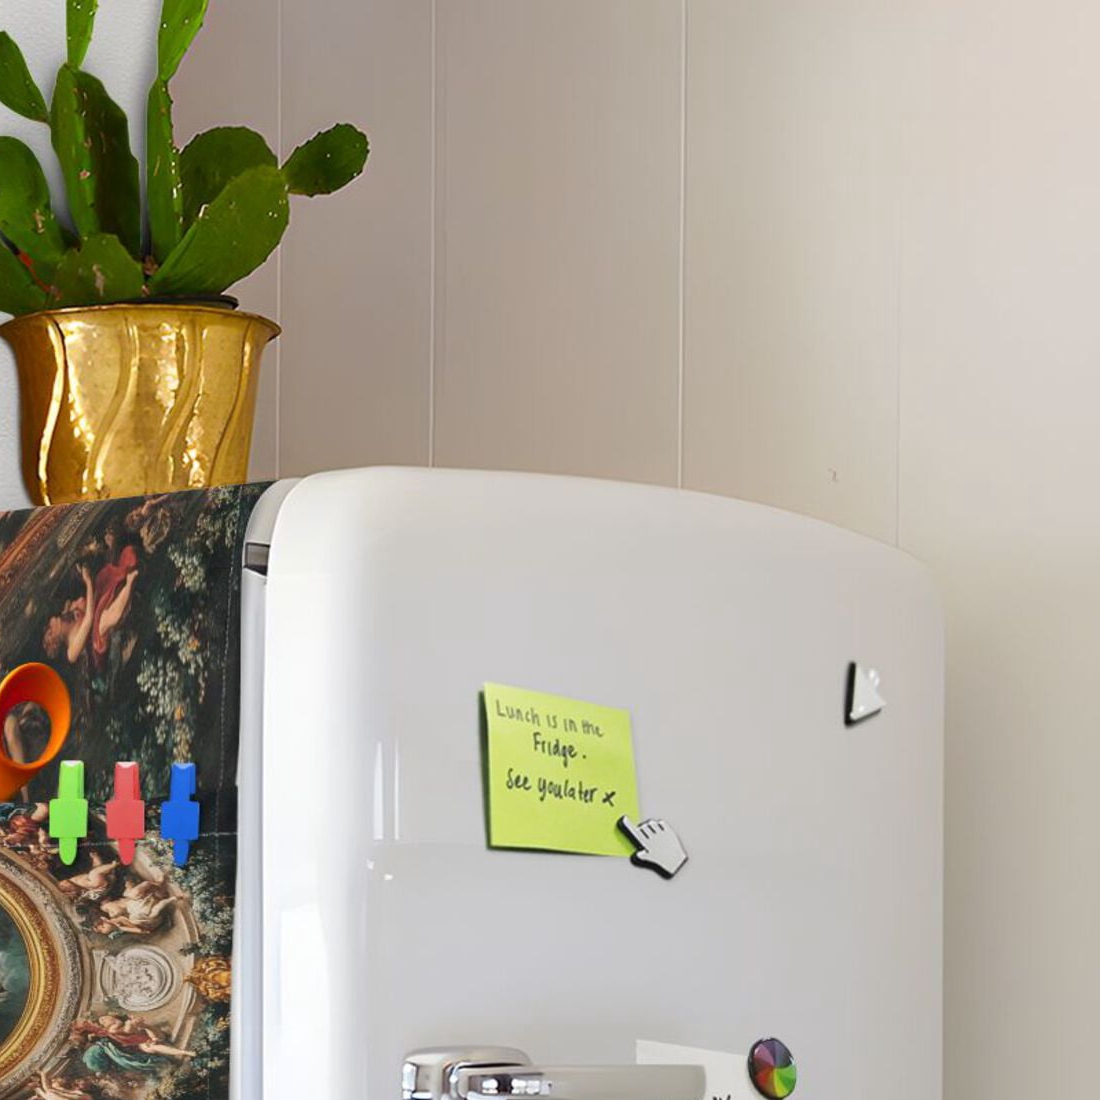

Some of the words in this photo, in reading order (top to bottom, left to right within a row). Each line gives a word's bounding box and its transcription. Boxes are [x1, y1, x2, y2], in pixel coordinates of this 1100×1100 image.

[495, 699, 541, 727] Lunch
[545, 714, 558, 730] is
[563, 718, 578, 733] in
[581, 718, 604, 737] the
[506, 768, 532, 790] See
